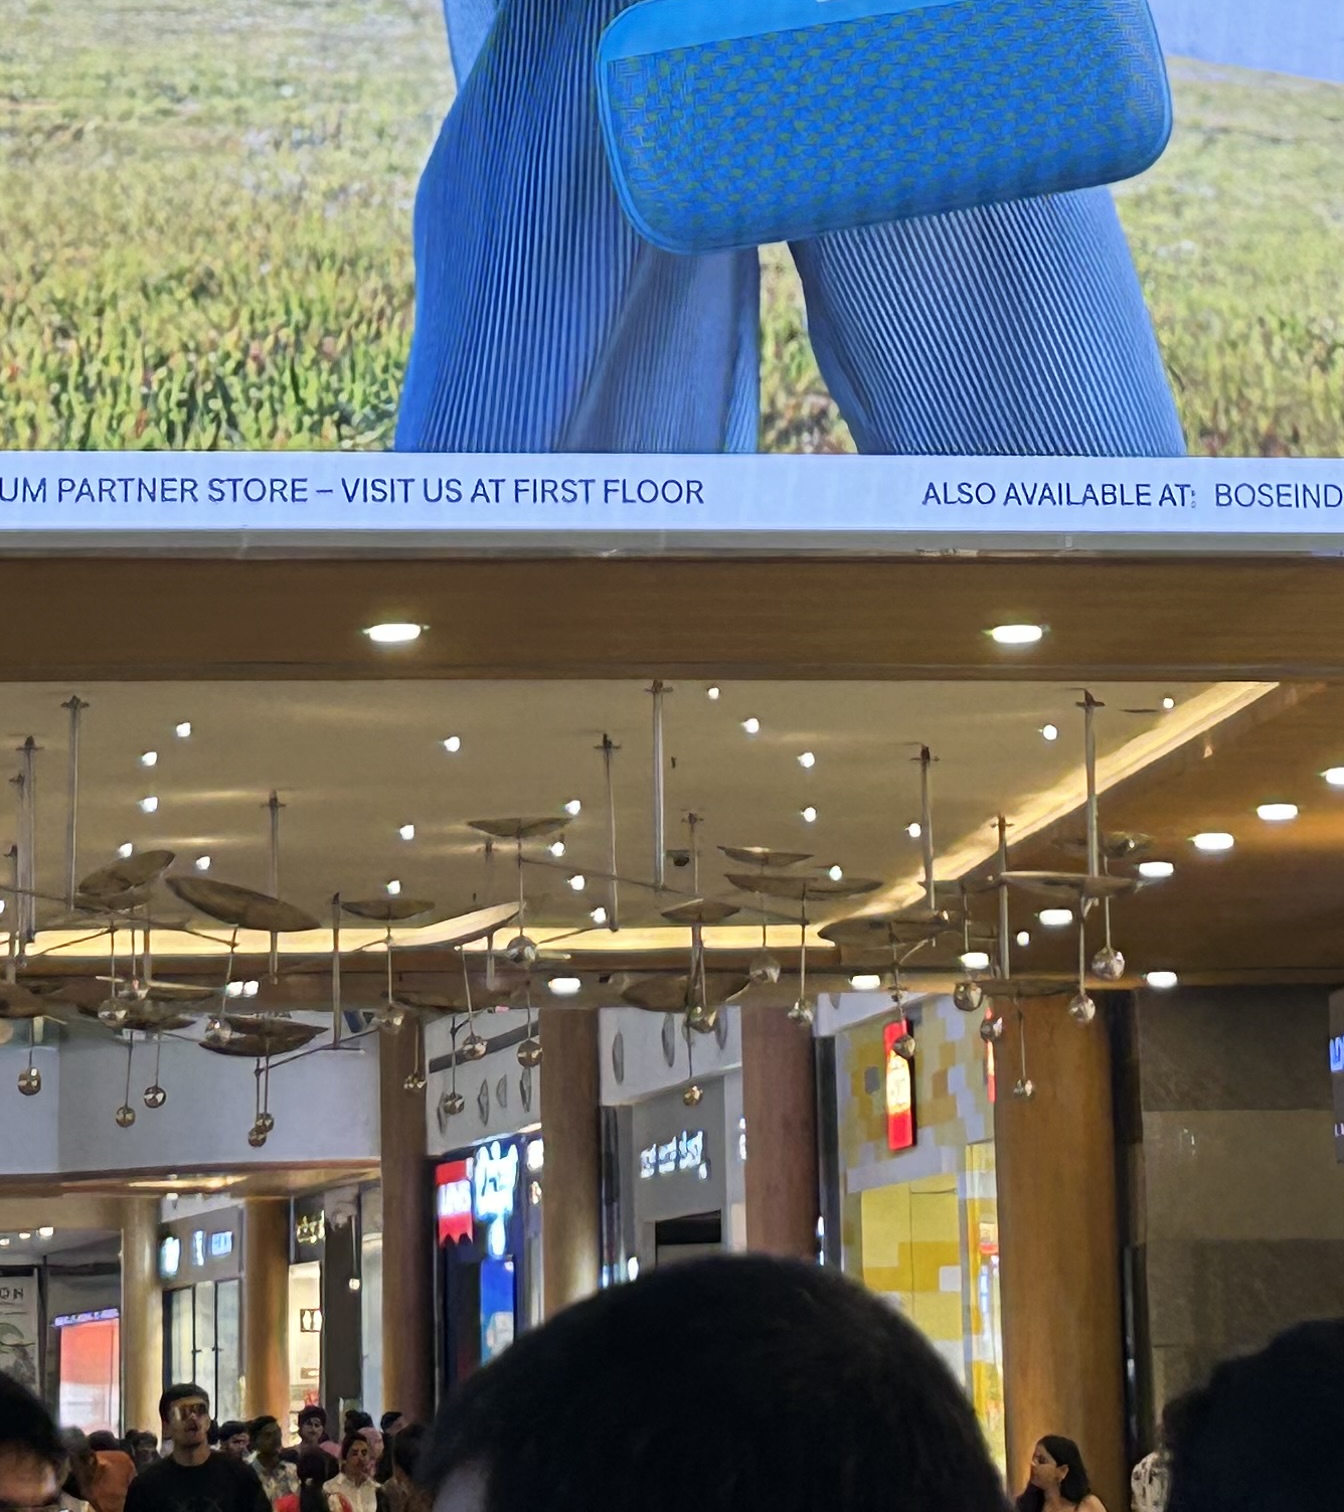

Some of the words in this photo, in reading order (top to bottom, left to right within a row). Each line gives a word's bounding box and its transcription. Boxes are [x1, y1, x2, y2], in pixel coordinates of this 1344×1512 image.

[58, 477, 199, 503] PARTNER
[208, 477, 308, 503] STORE
[341, 477, 416, 504] VISIT
[423, 477, 463, 504] US
[470, 478, 506, 504] AT
[514, 478, 596, 504] FIRST
[603, 478, 704, 505] FLOOR
[921, 481, 996, 506] ALSO
[1003, 481, 1152, 507] AVAILABLE
